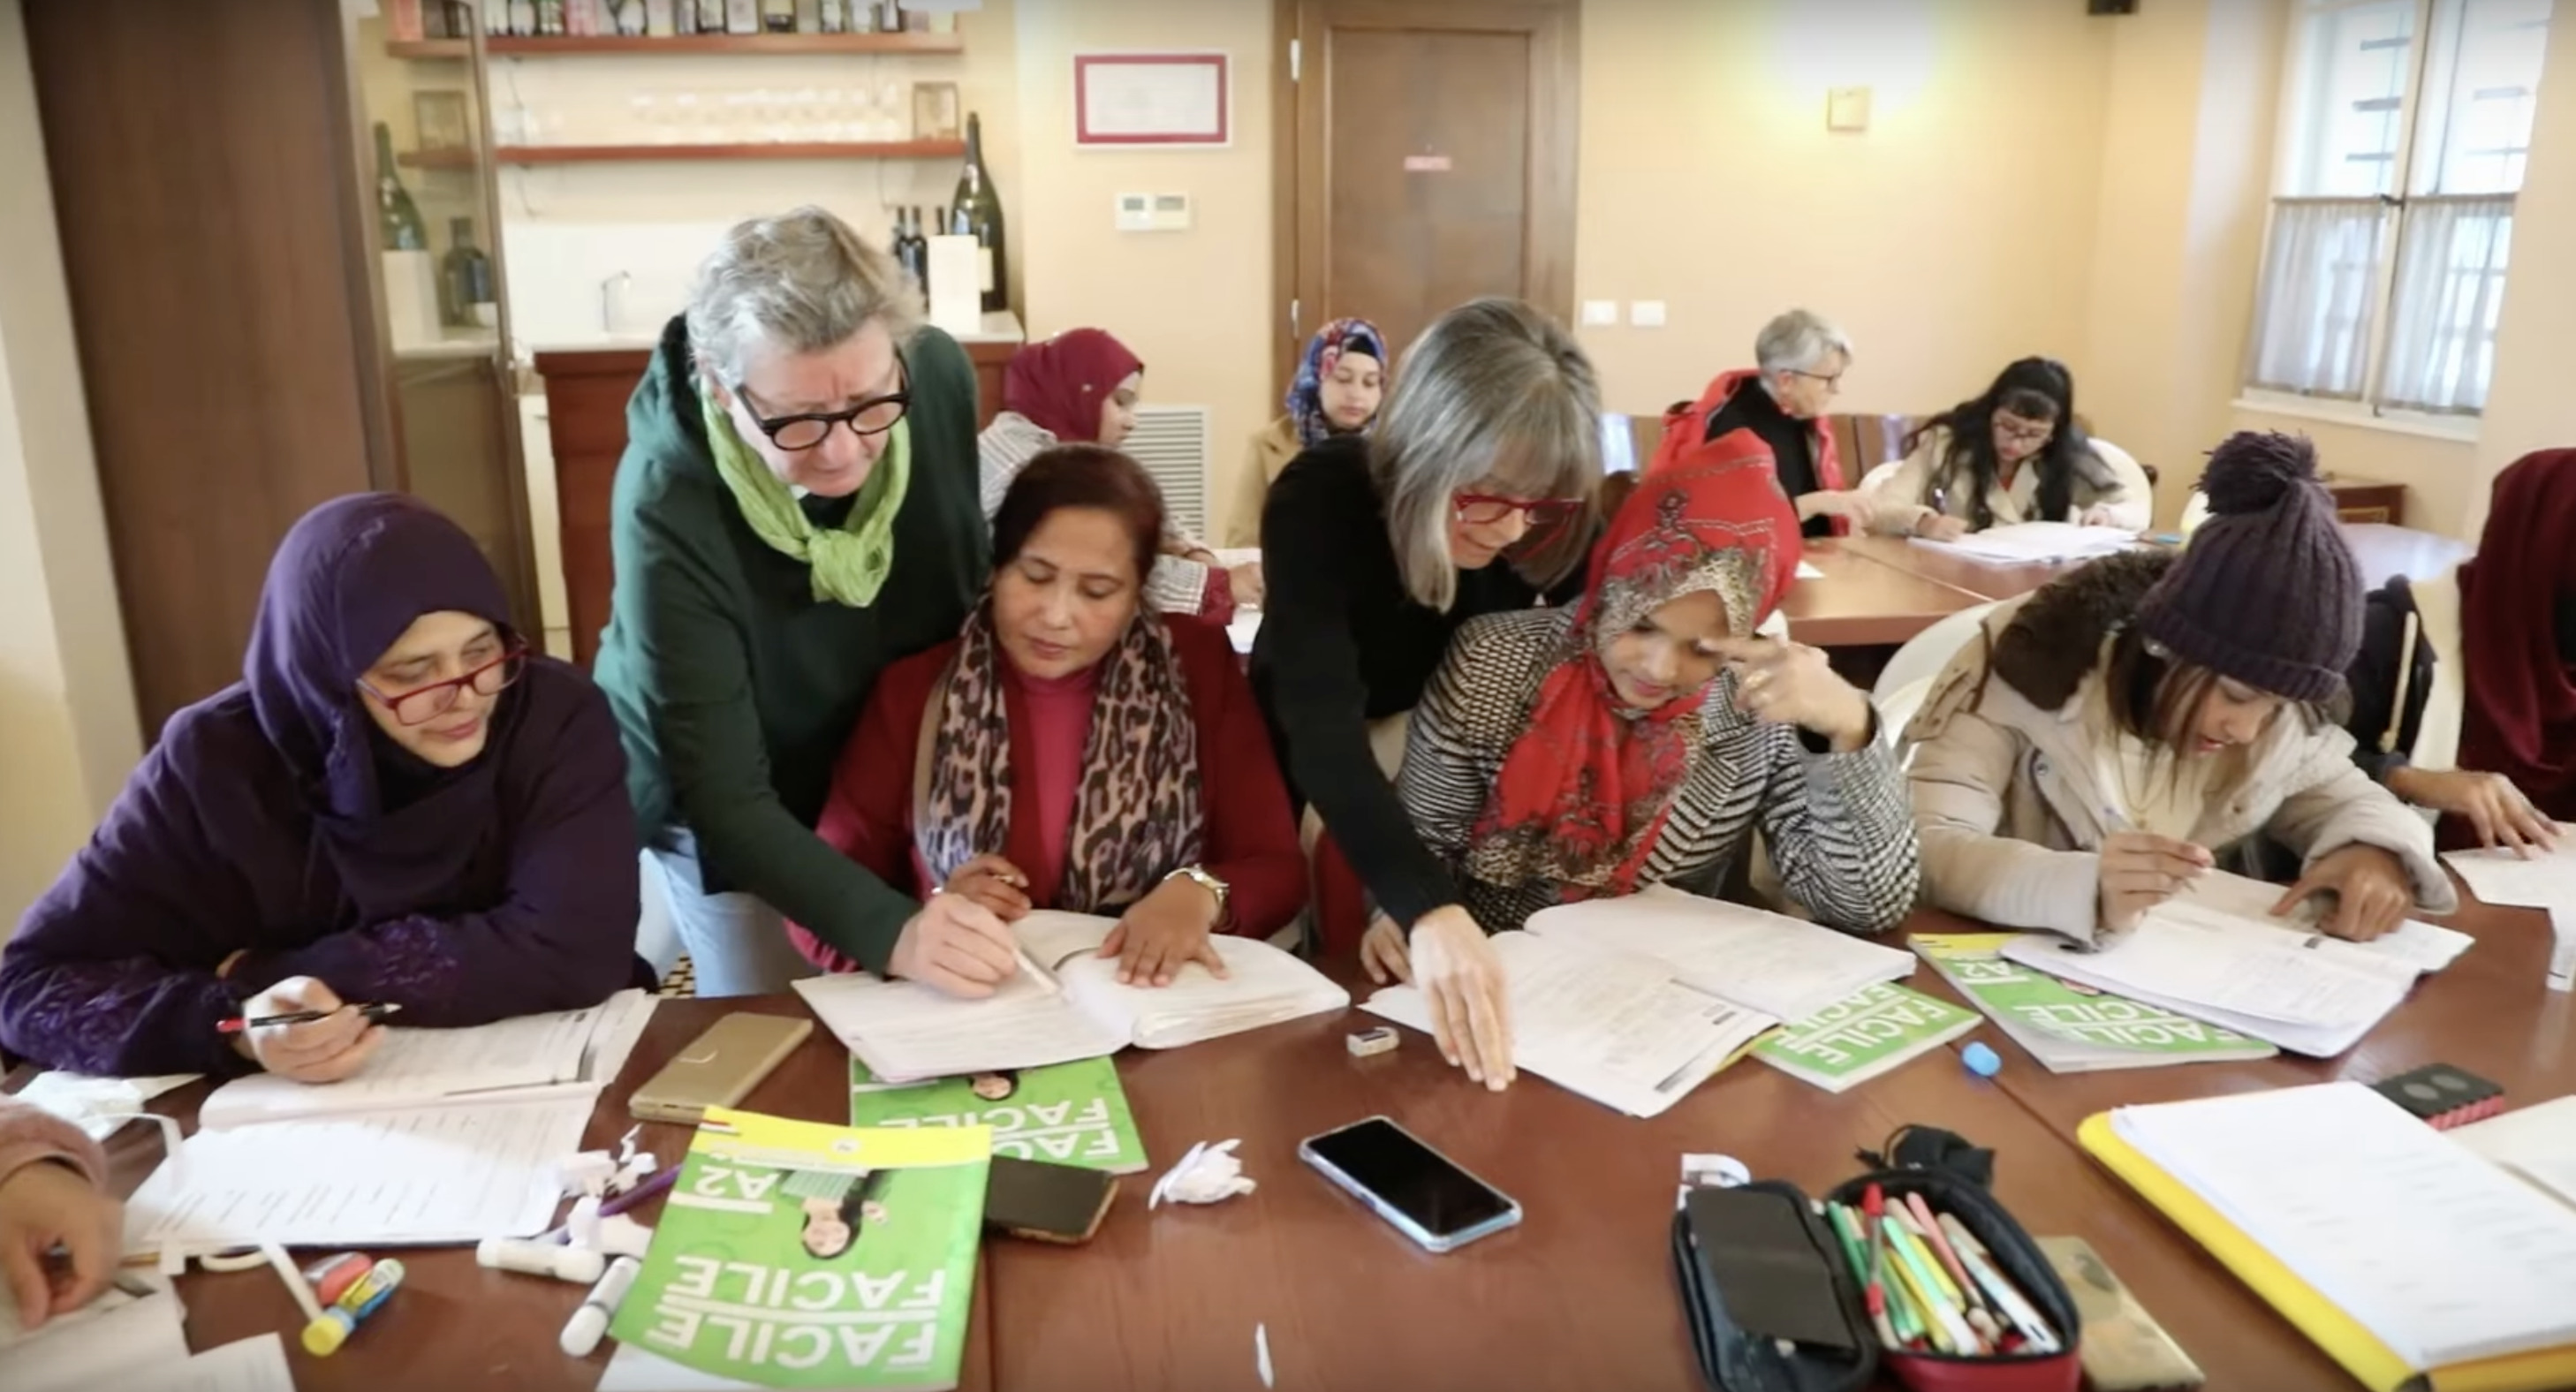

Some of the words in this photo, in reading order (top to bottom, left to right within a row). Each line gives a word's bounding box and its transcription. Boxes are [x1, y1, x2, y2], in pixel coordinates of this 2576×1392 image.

[1954, 960, 2012, 978] A2
[1809, 998, 1949, 1065] FACILE
[992, 1129, 1120, 1161] FAC
[694, 1164, 781, 1200] A2
[664, 1255, 946, 1310] FACILE
[646, 1303, 937, 1369] FACILE
